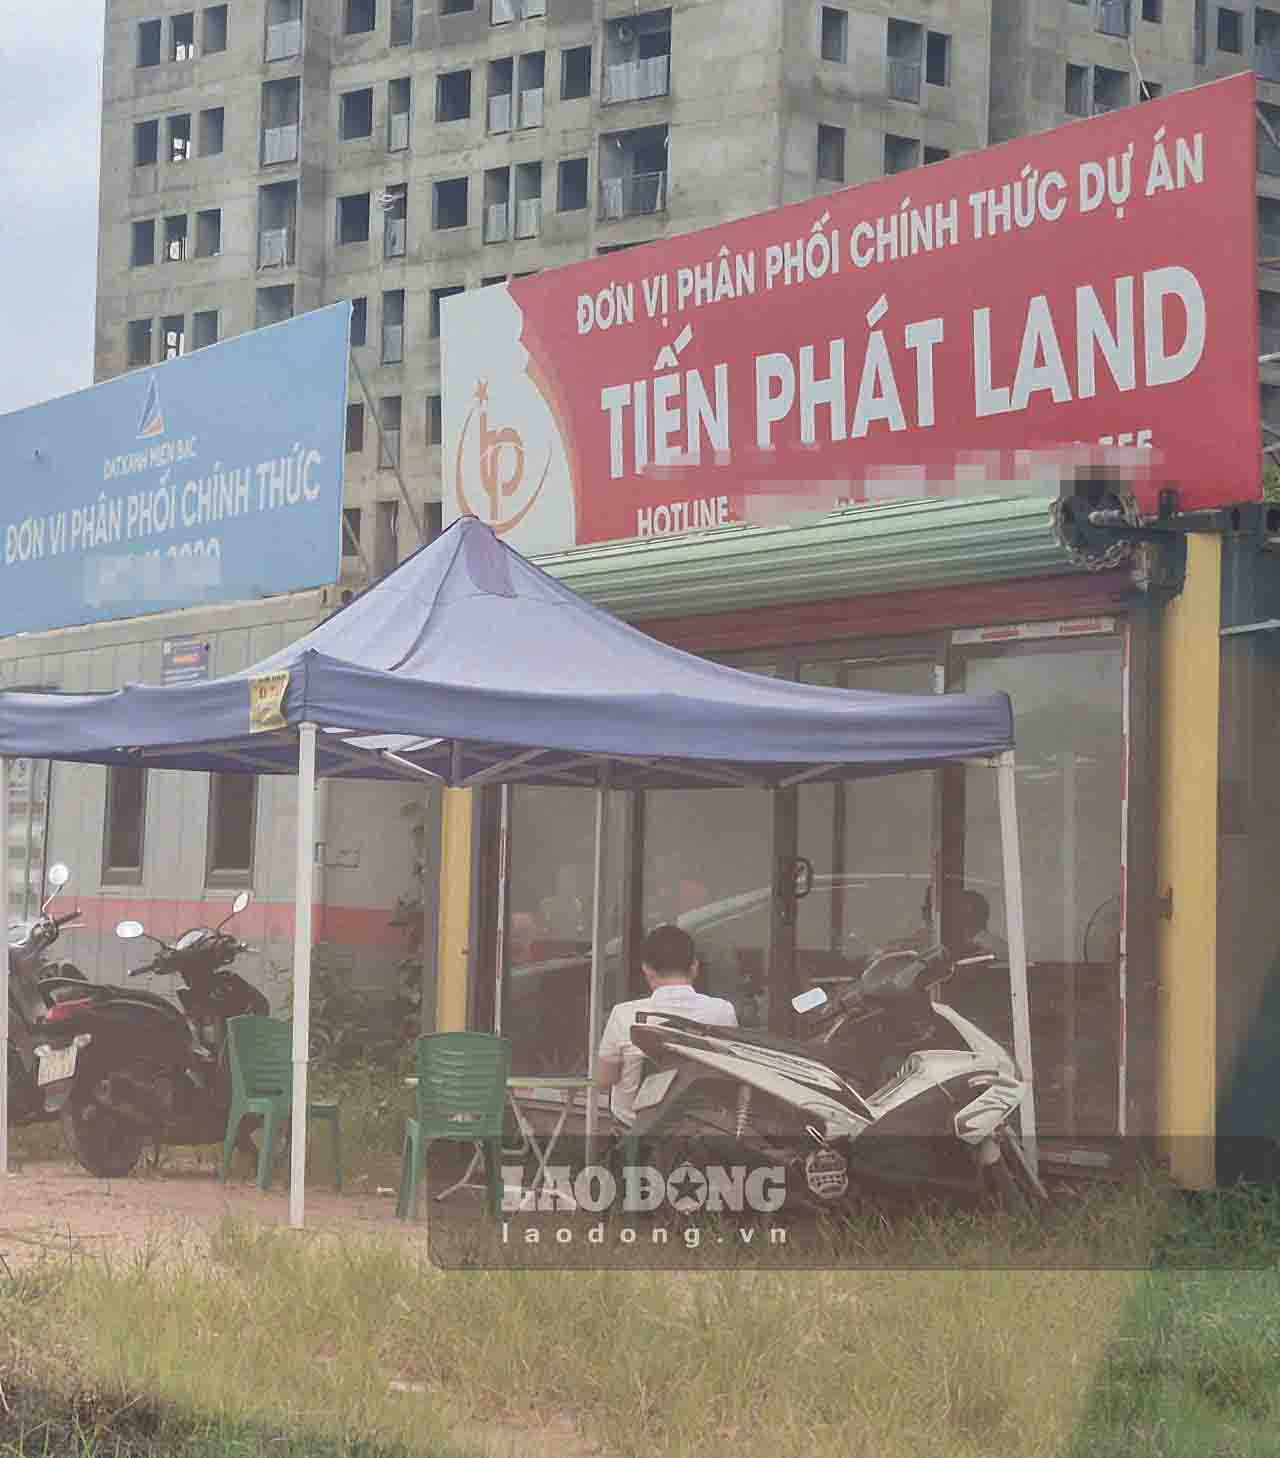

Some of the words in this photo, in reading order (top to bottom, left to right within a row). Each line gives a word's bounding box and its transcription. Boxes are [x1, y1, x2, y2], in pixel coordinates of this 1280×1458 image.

[576, 281, 634, 334] ĐƠN
[642, 273, 668, 327] VỊ
[677, 245, 755, 310] PHÂN
[766, 210, 839, 289] PHỐI
[850, 197, 959, 268] CHÍNH
[969, 163, 1067, 240] THỨC
[1079, 142, 1134, 219] DỰ
[1145, 125, 1204, 196] ÁN
[601, 323, 730, 480] TIẾN
[755, 294, 944, 449] PHÁT
[972, 265, 1207, 418] LAND
[71, 492, 121, 550] PHÂN
[182, 461, 248, 529] CHÍNH
[255, 441, 321, 511] THỨC
